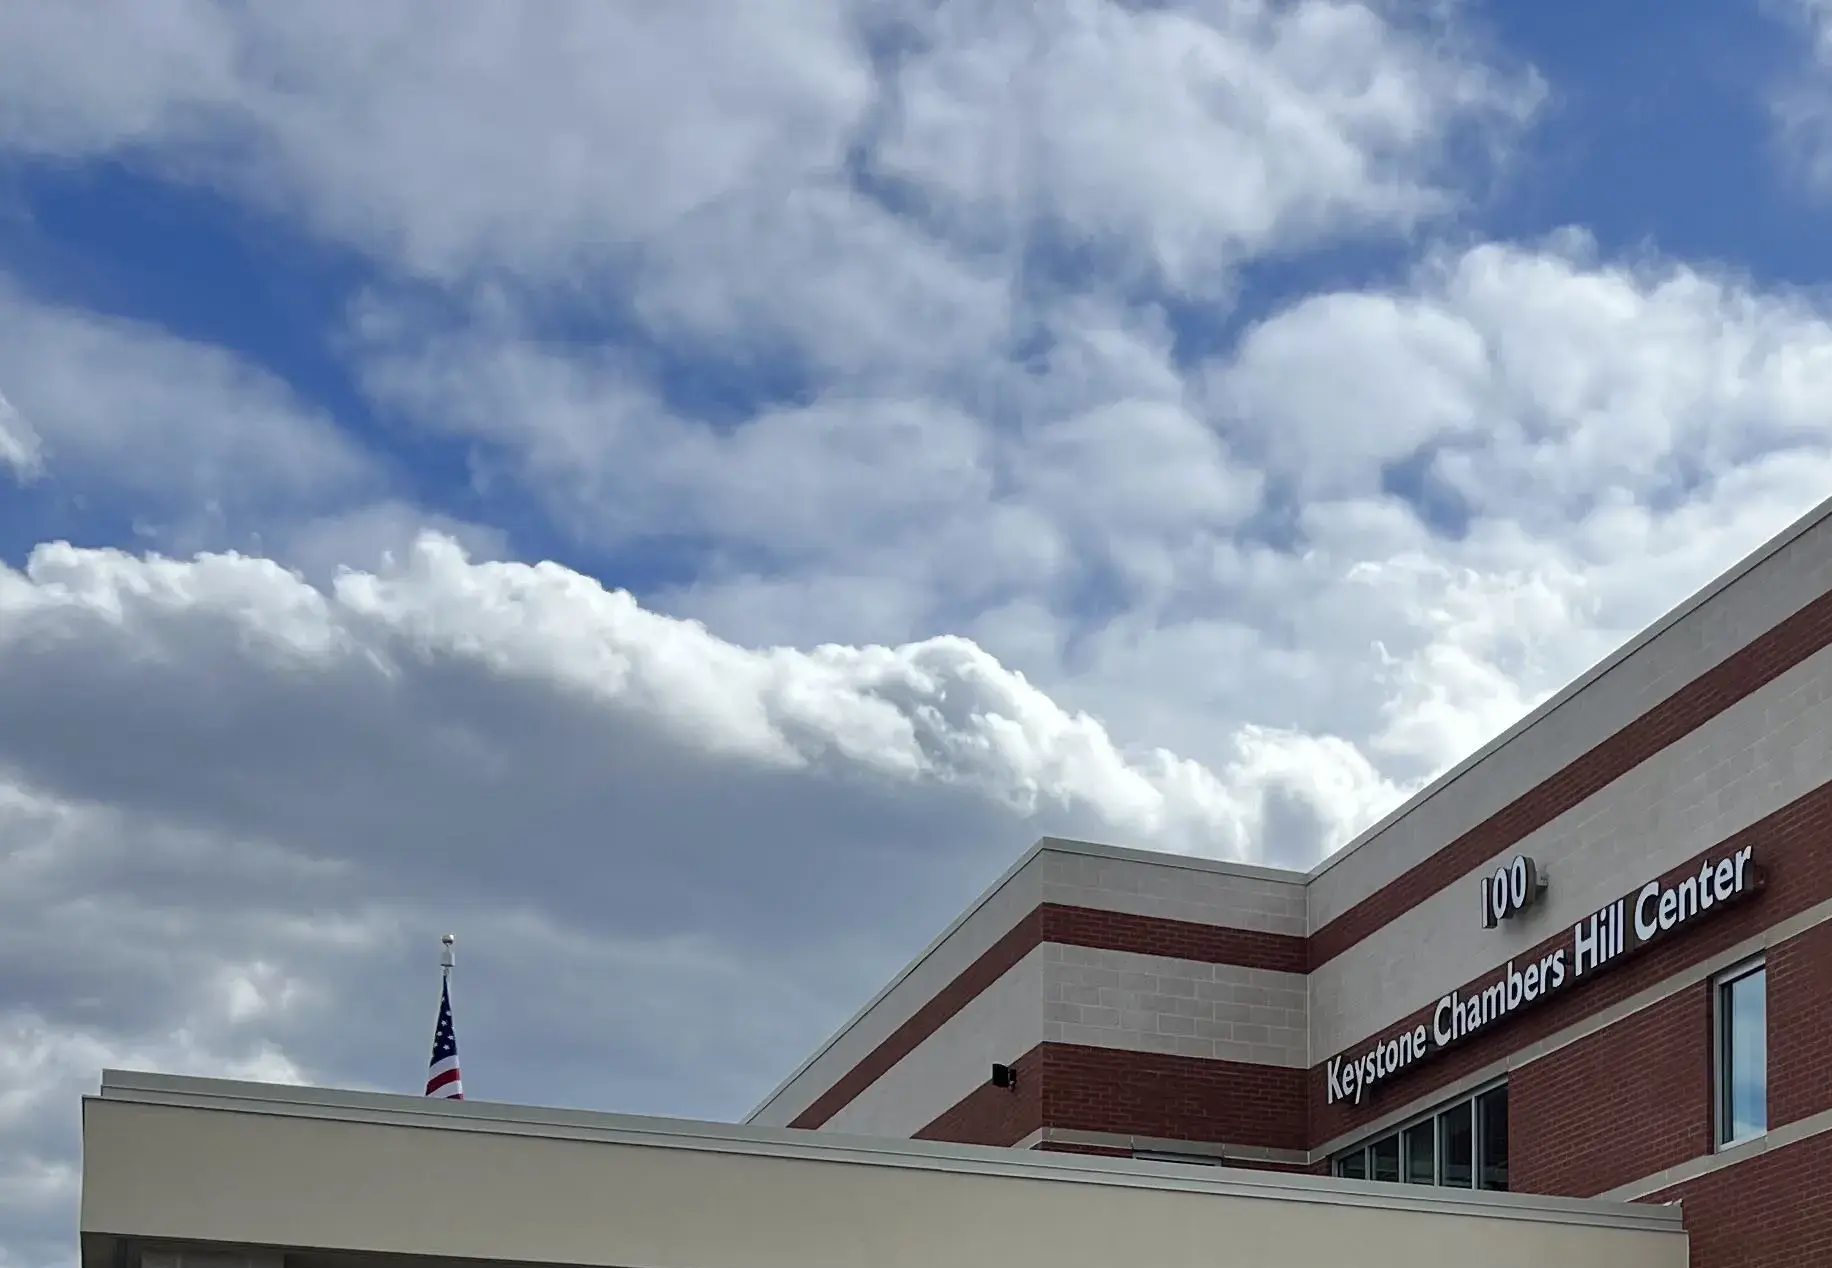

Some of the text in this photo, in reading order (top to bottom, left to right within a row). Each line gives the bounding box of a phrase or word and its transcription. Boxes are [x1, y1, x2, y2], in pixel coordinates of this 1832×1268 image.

[1327, 845, 1752, 1105] Keystone Chambers Hill Center
[1481, 855, 1527, 929] 100
